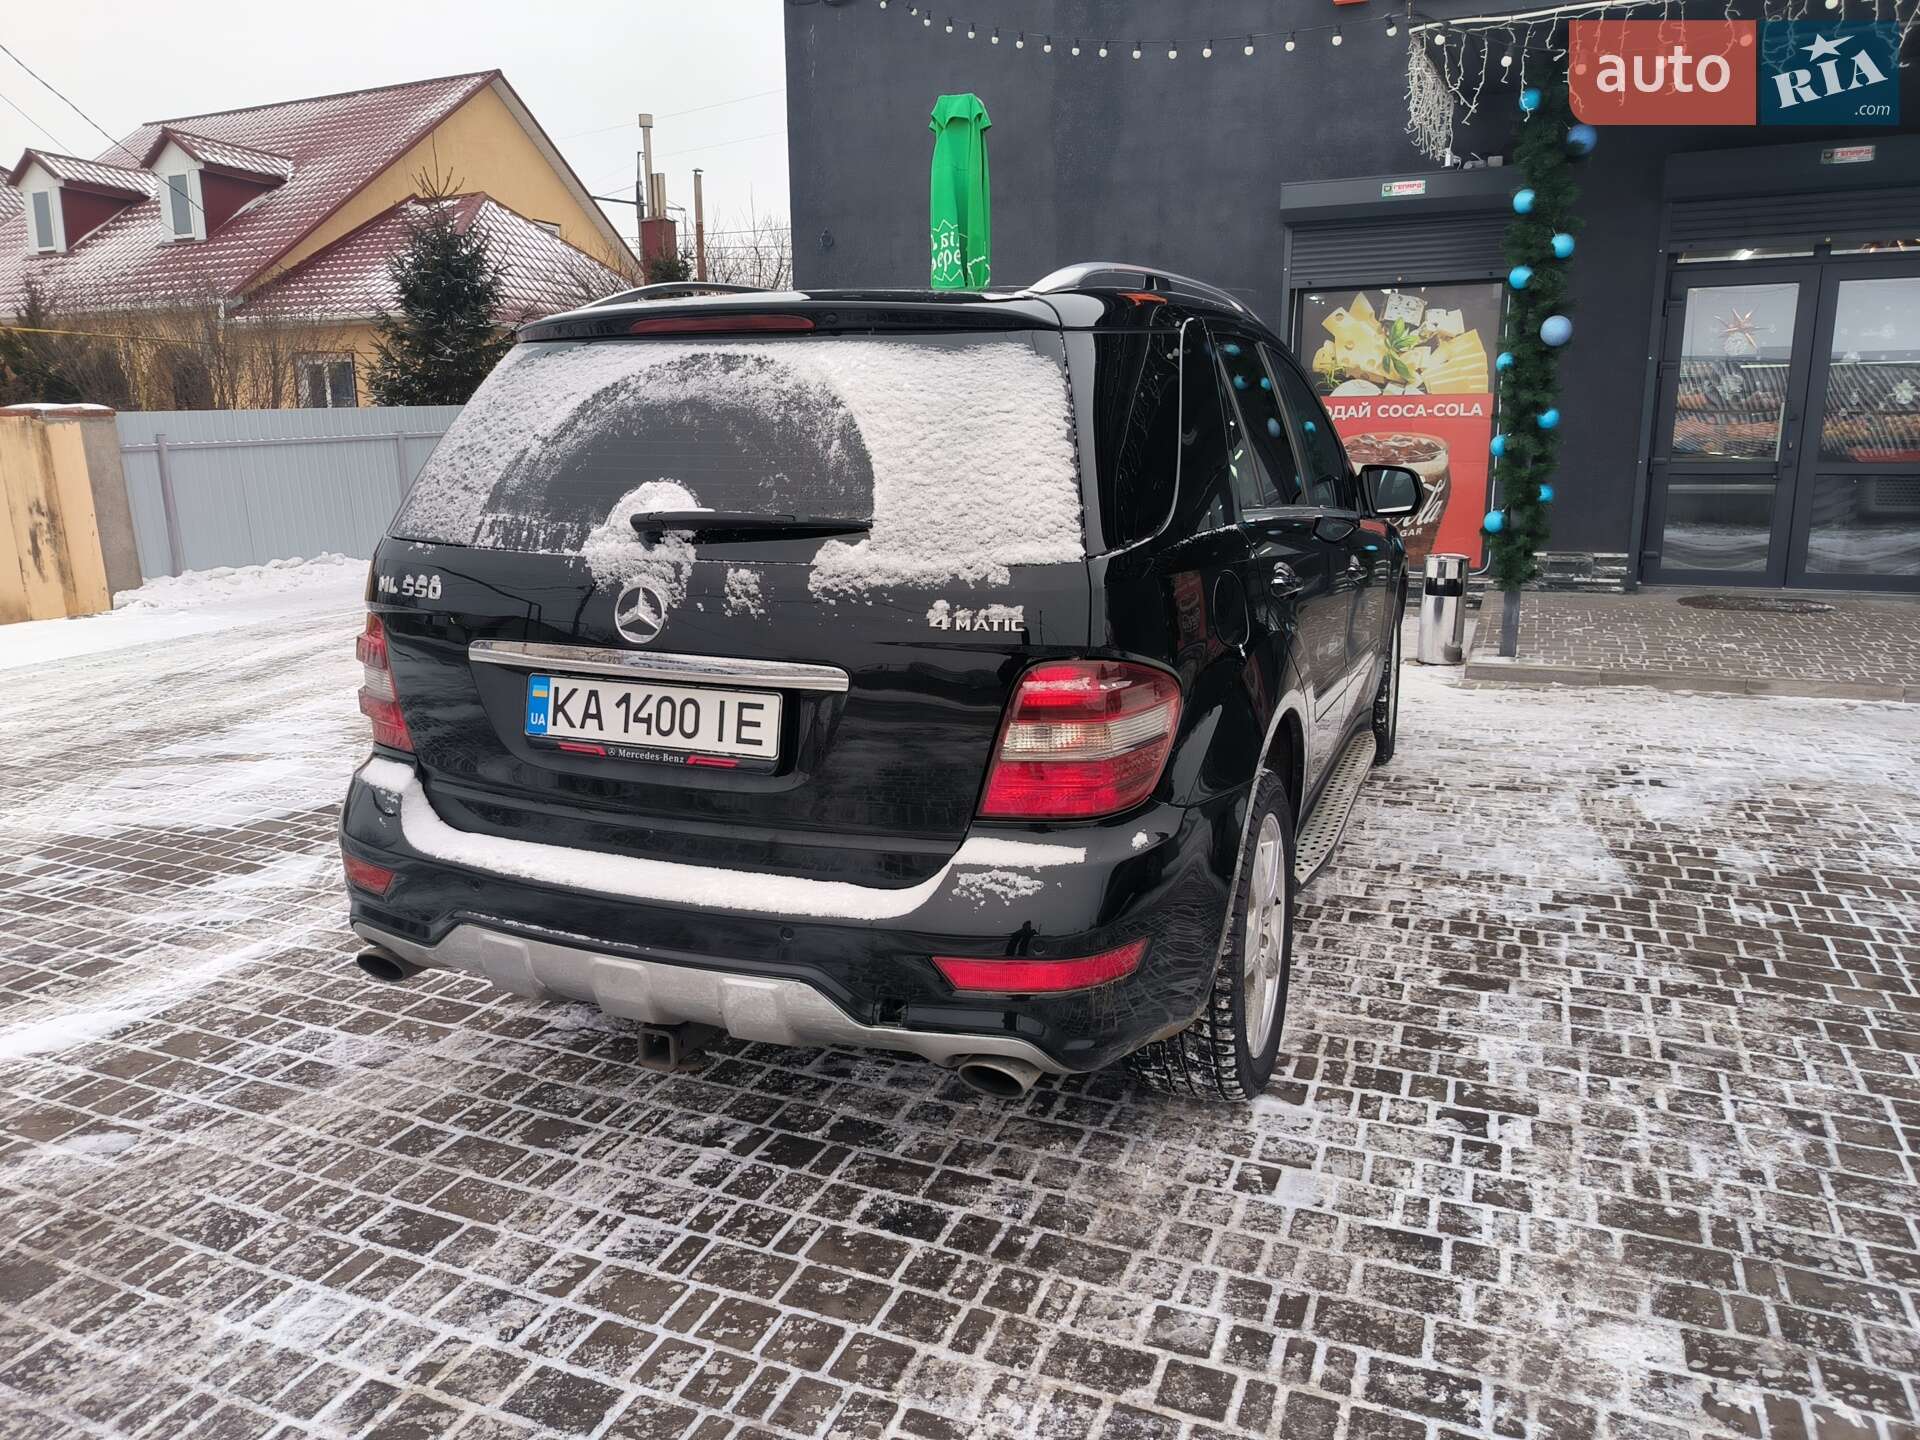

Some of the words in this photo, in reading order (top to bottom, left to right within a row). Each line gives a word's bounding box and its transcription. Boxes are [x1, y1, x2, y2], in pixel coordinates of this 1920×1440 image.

[1377, 403, 1483, 418] COCA-COLA
[531, 712, 546, 727] UA
[552, 686, 604, 731] KA
[615, 692, 701, 740] 1400
[717, 700, 765, 747] IE
[618, 749, 685, 764] Mercedes-Benz
